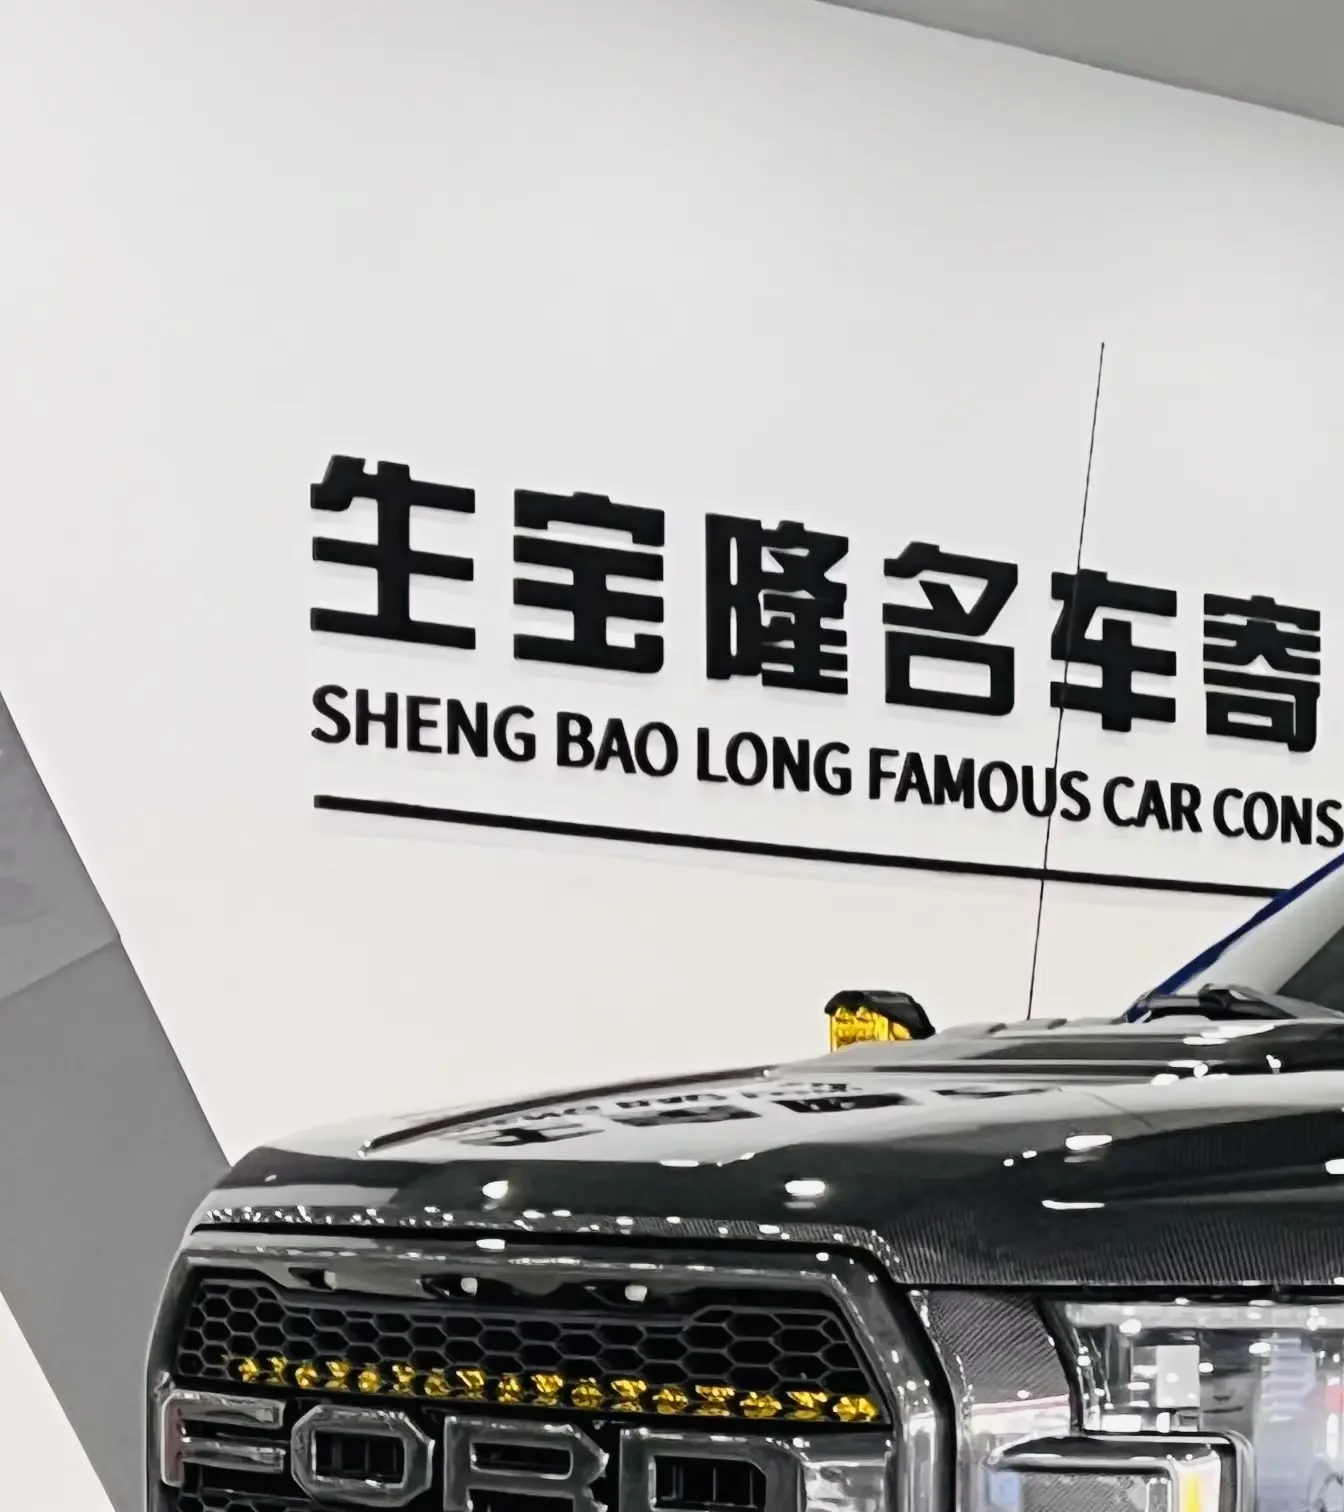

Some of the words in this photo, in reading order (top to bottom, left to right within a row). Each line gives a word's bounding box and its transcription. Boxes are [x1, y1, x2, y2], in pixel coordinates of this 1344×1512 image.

[311, 683, 536, 762] SHENG
[556, 711, 679, 778] BAO
[697, 727, 853, 797] LONG
[868, 747, 1091, 823] FAMOUS
[1103, 775, 1201, 832] CAR
